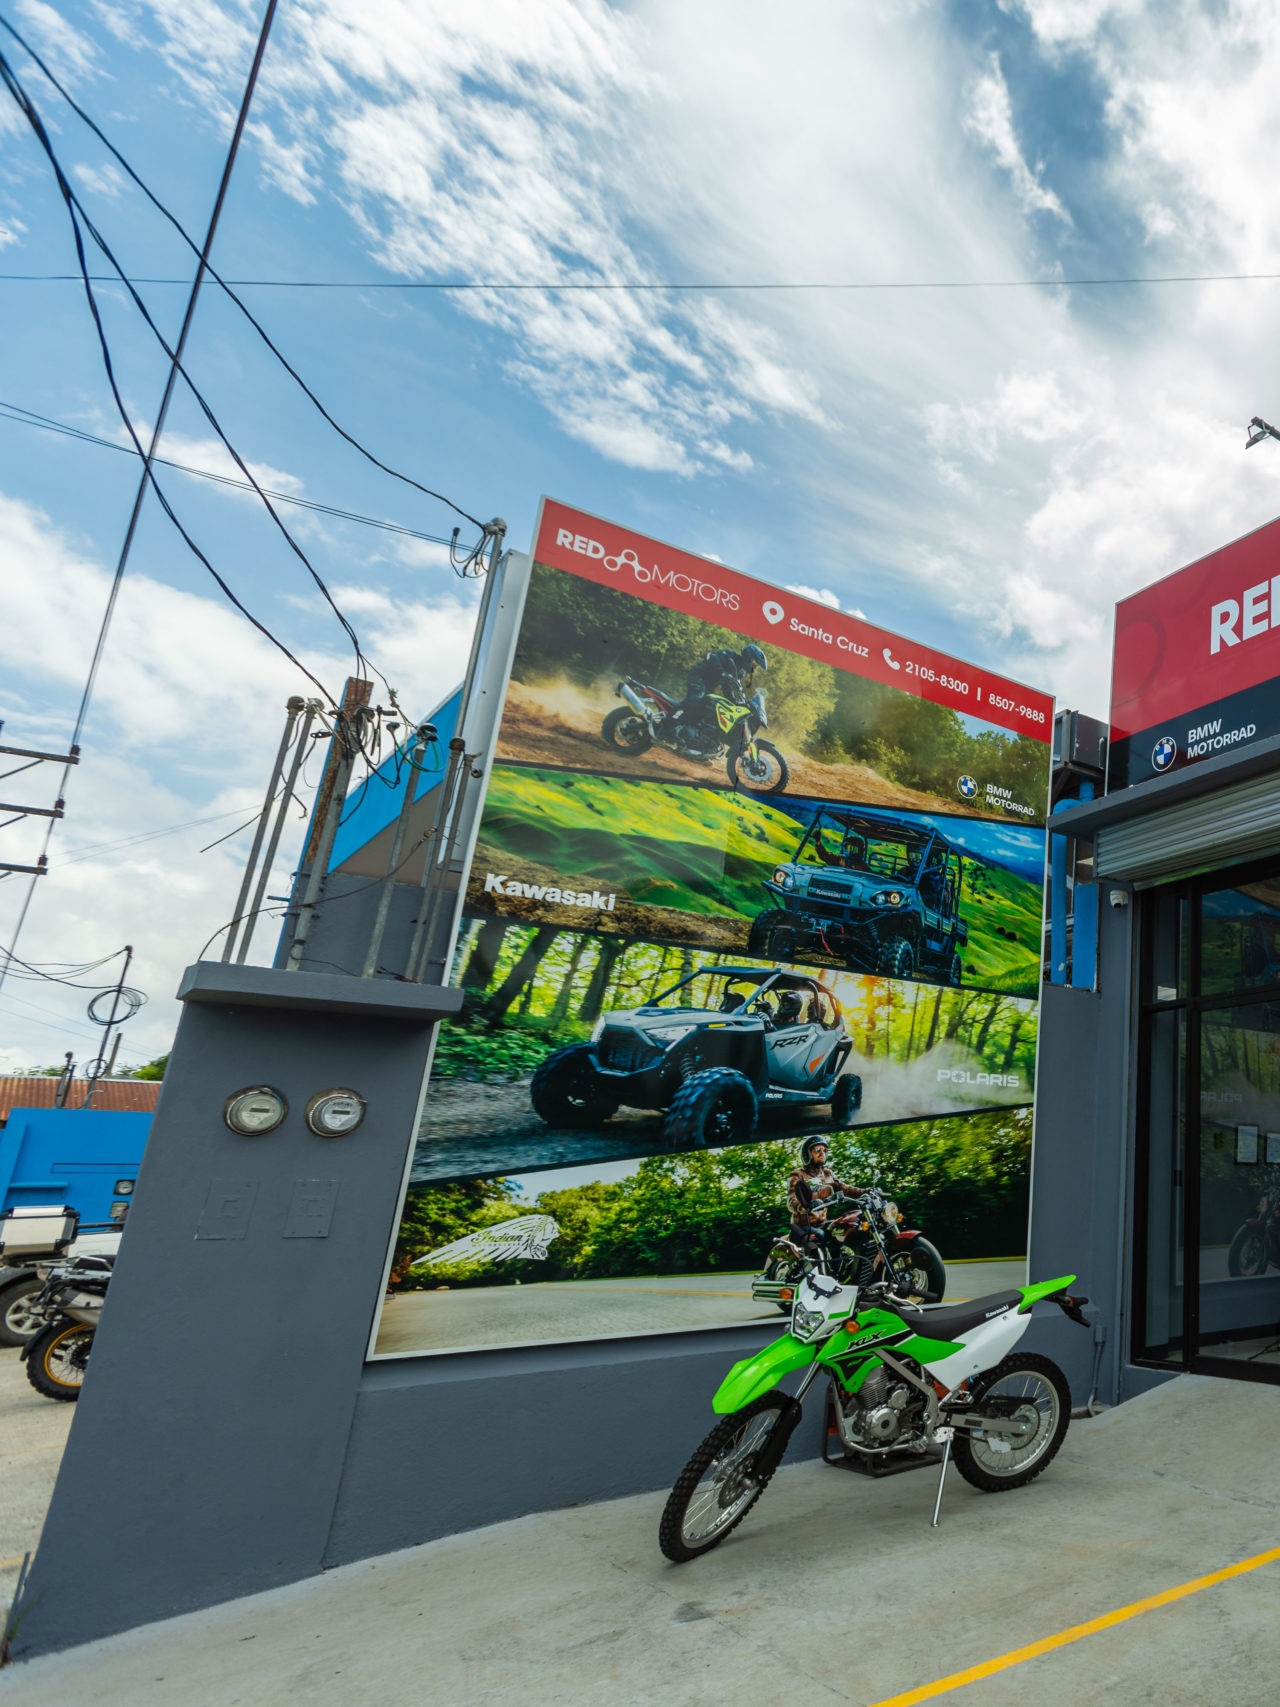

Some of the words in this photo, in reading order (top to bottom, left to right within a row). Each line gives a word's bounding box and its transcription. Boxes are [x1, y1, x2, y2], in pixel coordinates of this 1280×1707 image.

[555, 527, 606, 560] RED
[652, 563, 741, 611] MOTORS
[789, 617, 833, 645] Santa
[836, 635, 869, 658] Cruz
[905, 660, 969, 695] 2105-8300
[988, 692, 1046, 724] 8507-9888
[1187, 718, 1222, 744] BMW
[1187, 723, 1257, 760] MOTORRAD
[986, 783, 1012, 799] BMW
[985, 794, 1035, 816] MOTORRAD
[484, 872, 616, 911] Kawasaki
[770, 1034, 810, 1050] RZR
[937, 1069, 1020, 1088] POLARIS
[470, 1230, 524, 1244] Indian
[985, 1305, 1010, 1319] Kawasaki
[847, 1329, 888, 1351] KLX
